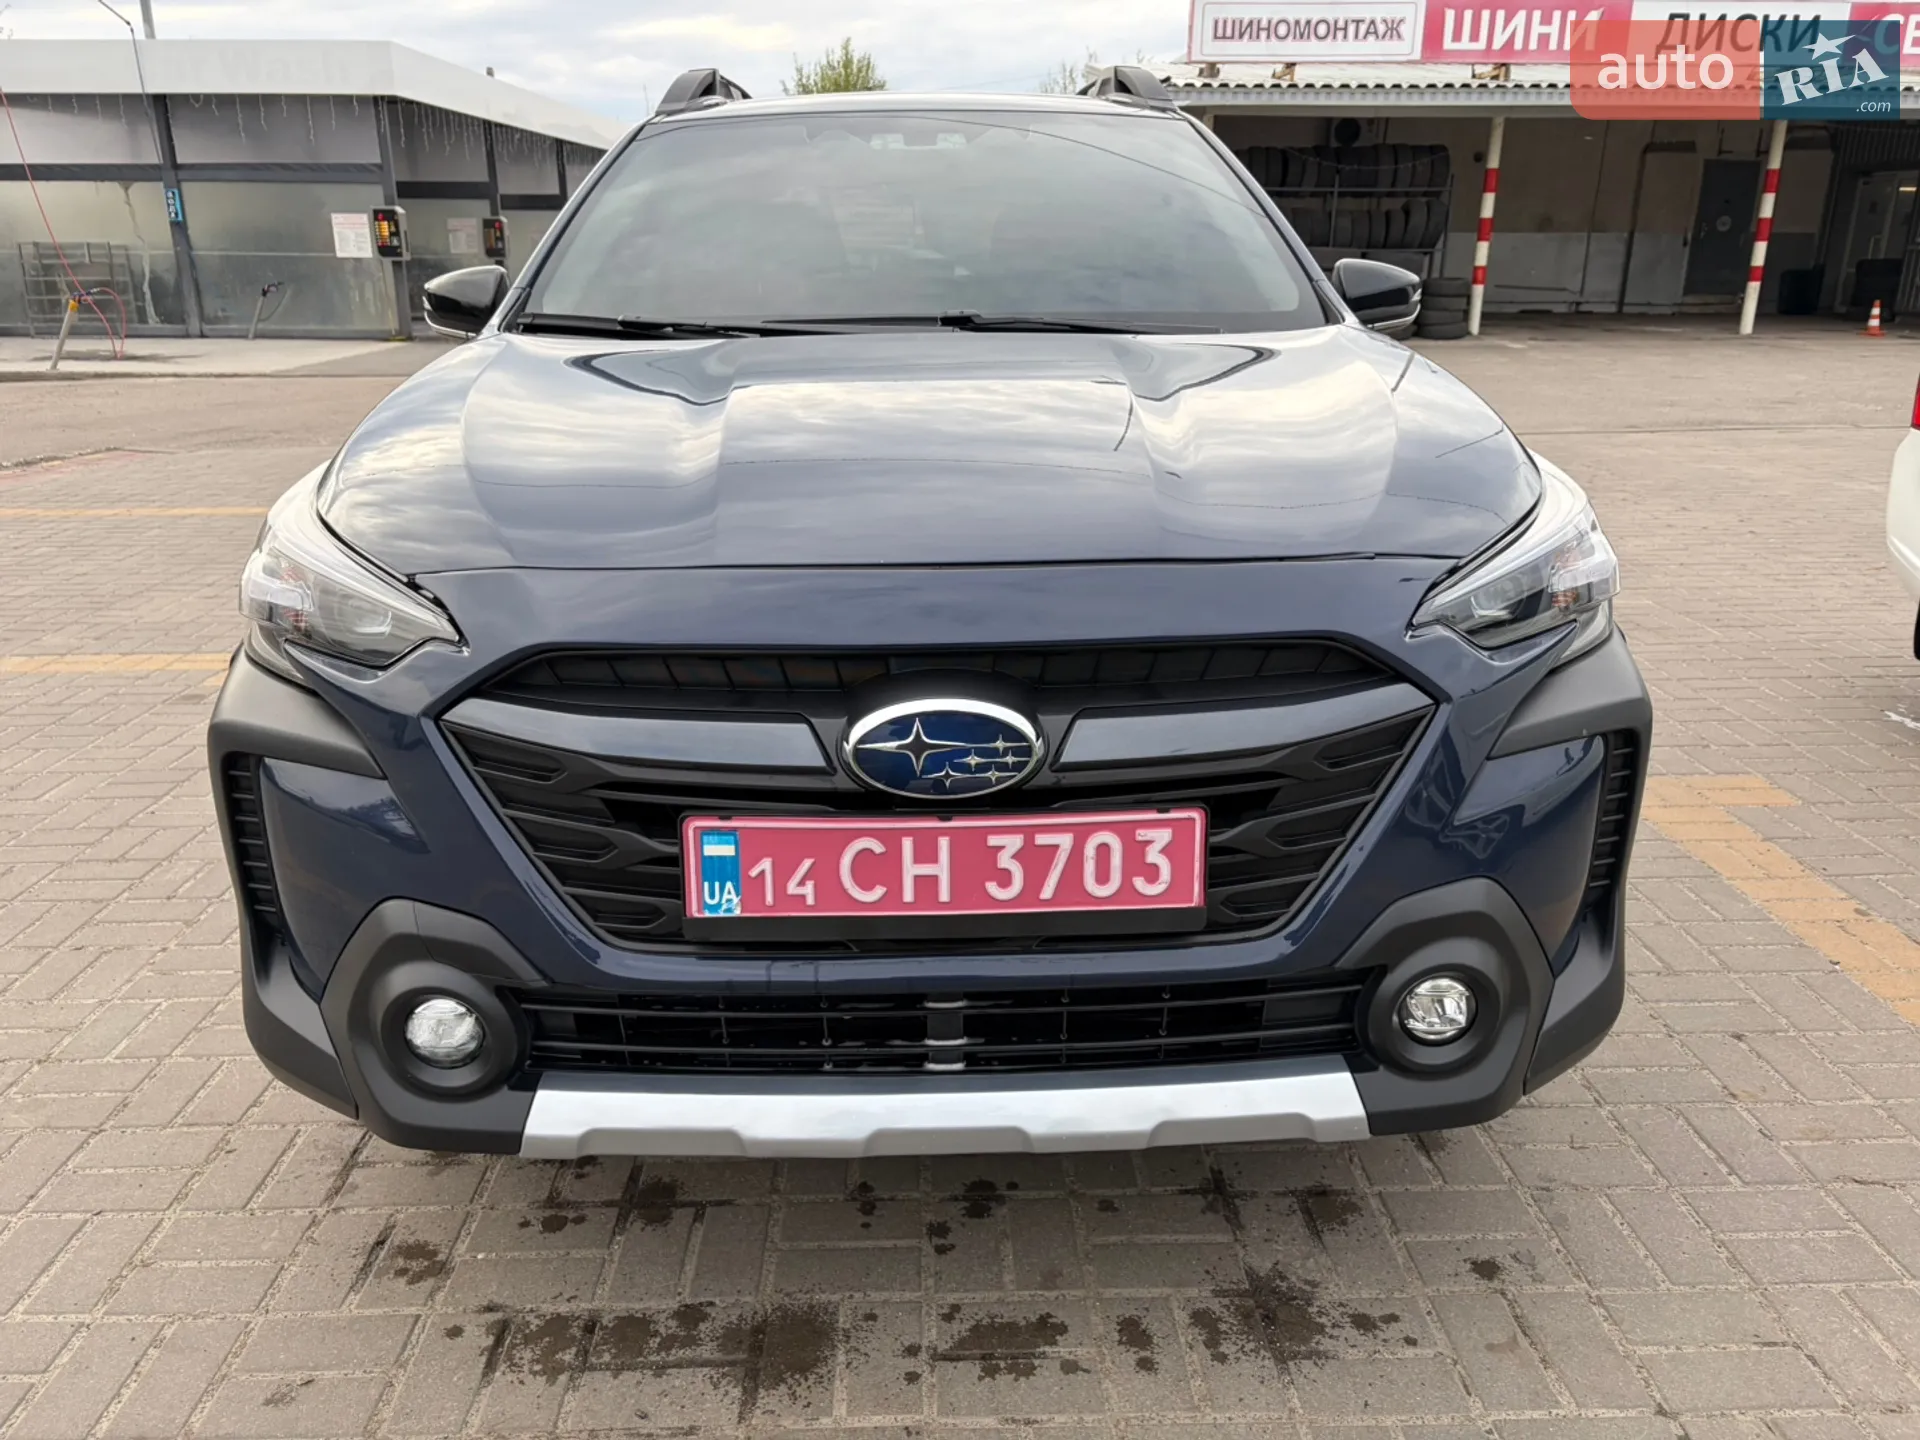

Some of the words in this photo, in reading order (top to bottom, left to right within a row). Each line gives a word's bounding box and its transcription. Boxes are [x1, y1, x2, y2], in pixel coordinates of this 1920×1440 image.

[1212, 17, 1406, 42] ШИНОМОНТАЖ
[1443, 9, 1604, 50] ШИНИ
[1654, 13, 1821, 58] ДИСКИ
[747, 857, 816, 907] 14
[838, 836, 951, 904] CH
[984, 827, 1174, 902] 3703
[703, 880, 741, 908] UA
